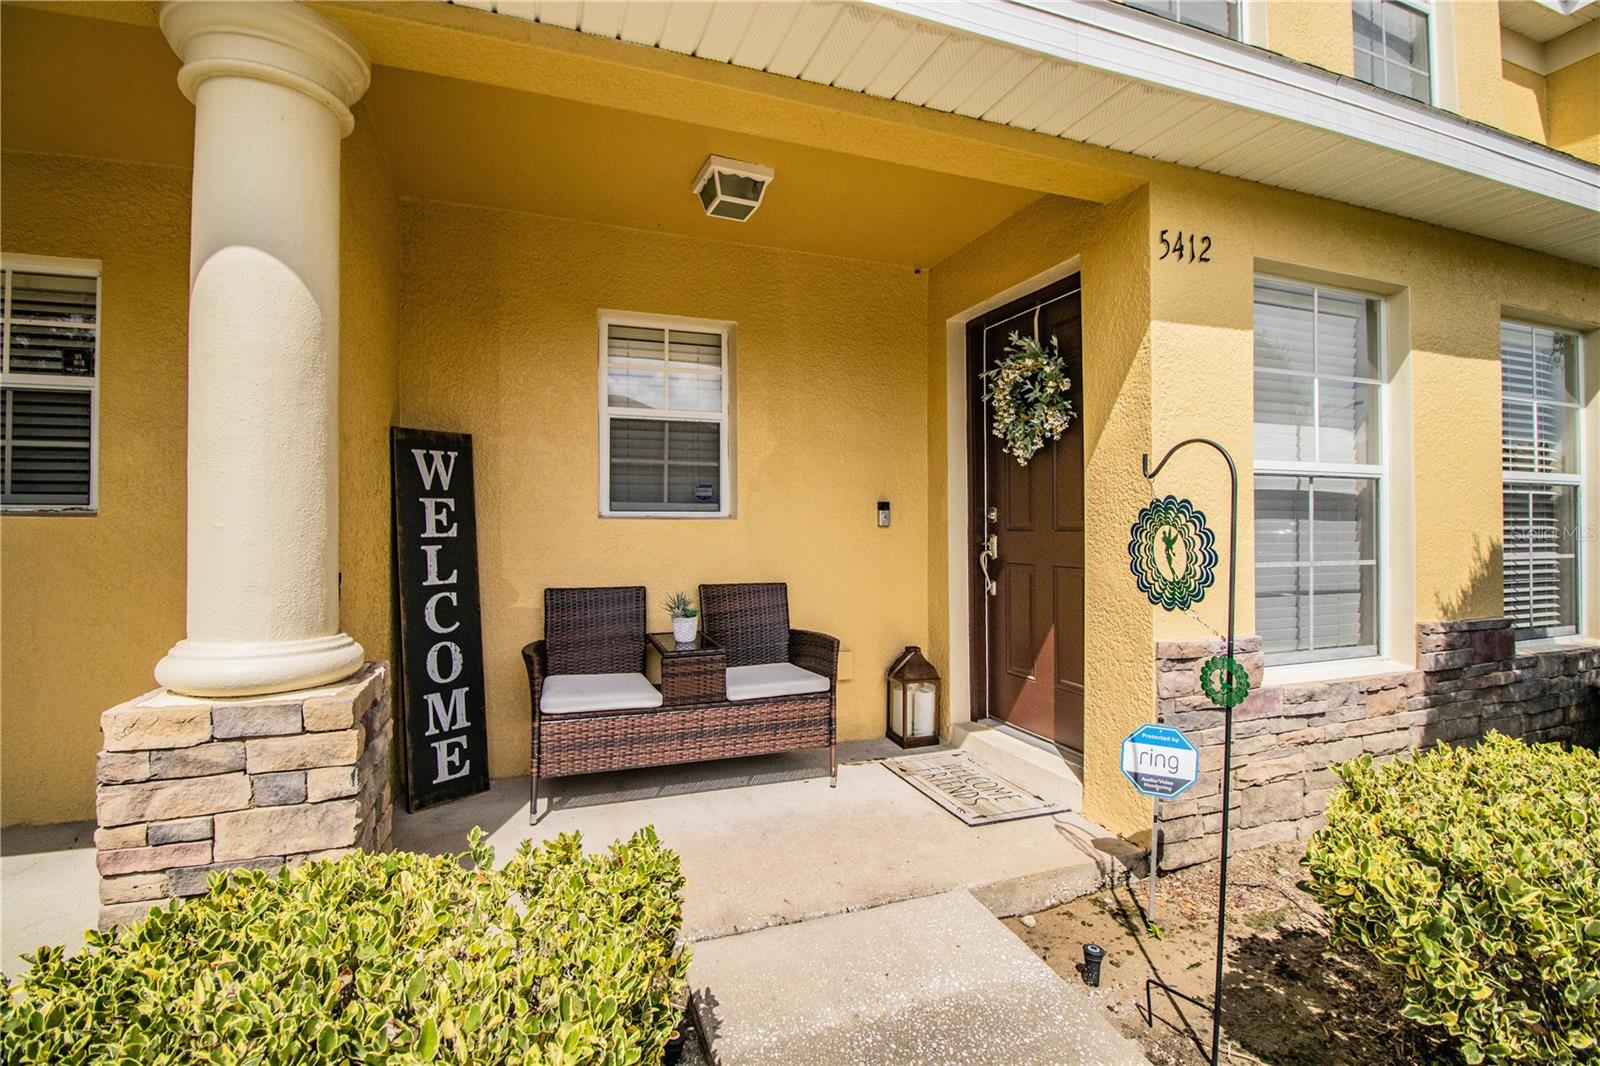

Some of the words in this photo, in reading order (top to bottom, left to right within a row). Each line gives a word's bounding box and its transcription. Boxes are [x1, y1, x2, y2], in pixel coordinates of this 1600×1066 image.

[1160, 230, 1211, 264] 5412
[411, 449, 471, 785] WELCOME
[1142, 733, 1171, 741] Protected
[1140, 749, 1179, 774] ring
[1143, 782, 1172, 792] Monitoring
